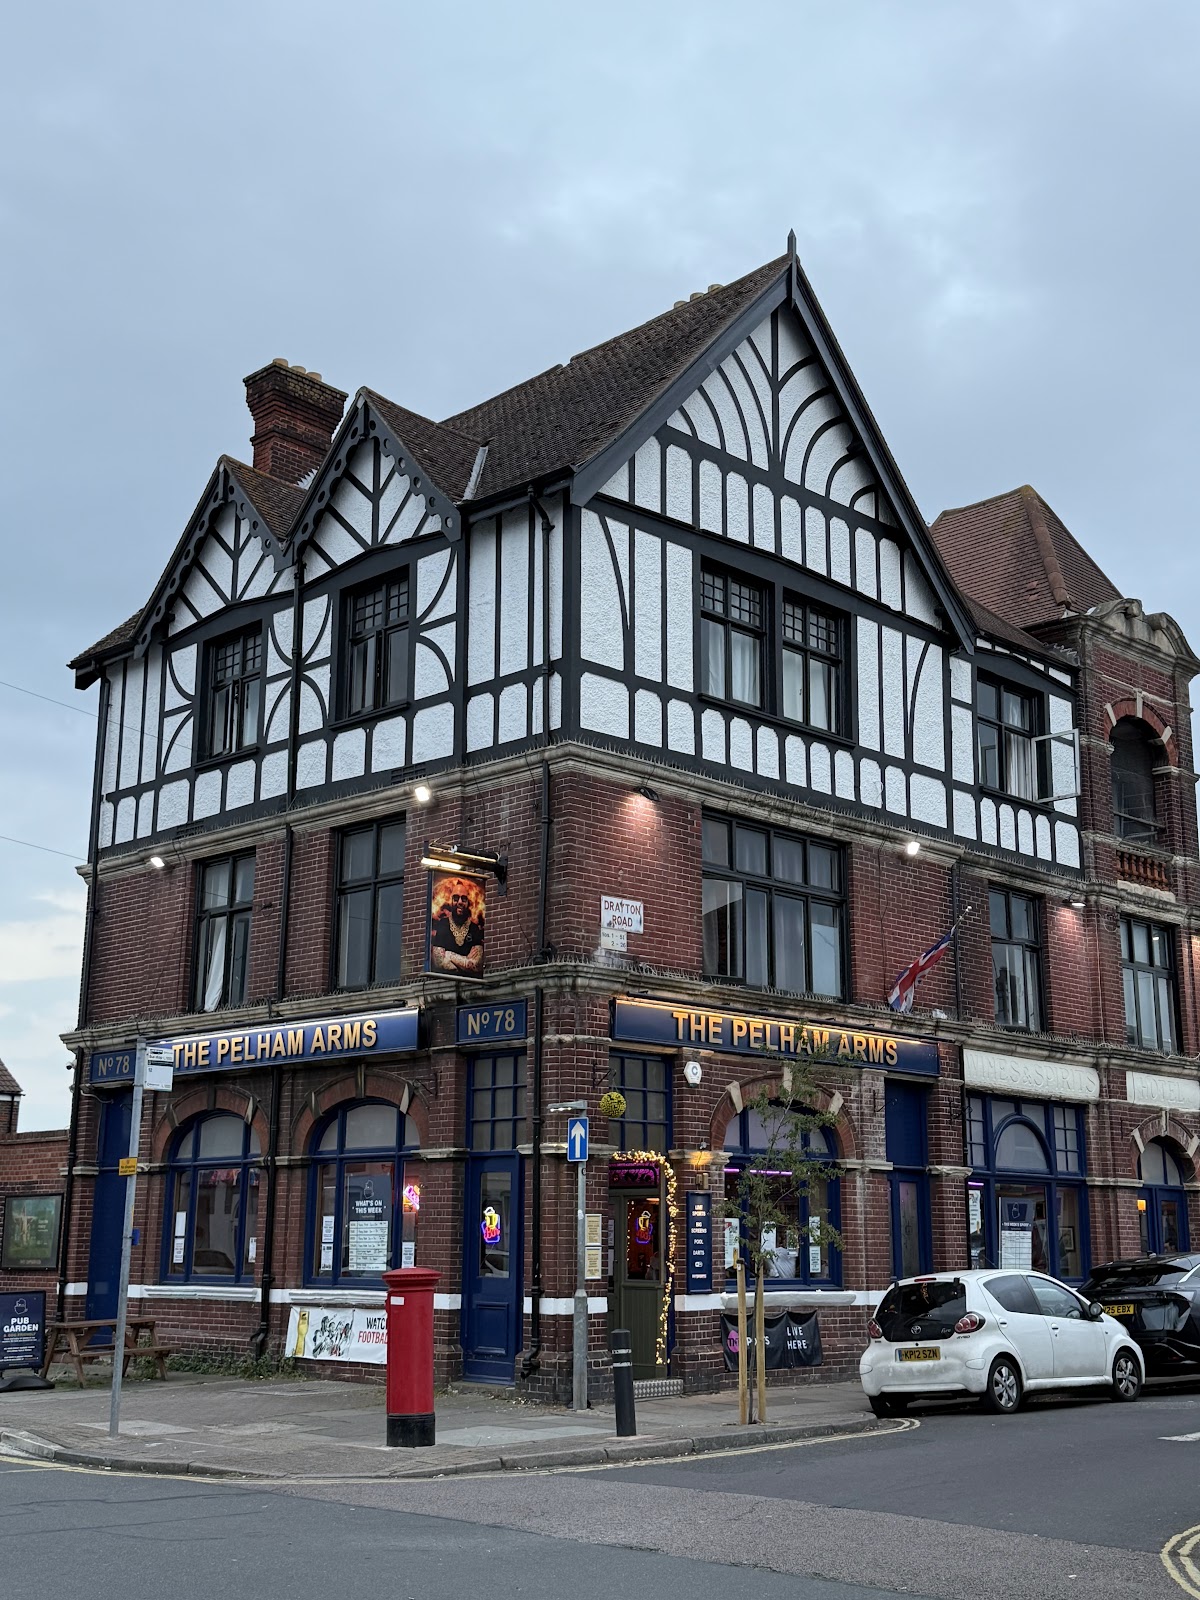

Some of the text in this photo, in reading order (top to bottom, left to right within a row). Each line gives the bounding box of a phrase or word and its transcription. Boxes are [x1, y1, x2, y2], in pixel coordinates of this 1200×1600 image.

[604, 900, 641, 915] DRAYTON
[612, 915, 633, 927] ROAD
[493, 1009, 515, 1033] 78
[172, 1019, 377, 1069] THE PELHAM ARMS
[672, 1011, 898, 1066] THE PELHAM ARMS
[115, 1055, 130, 1074] 78
[1138, 1076, 1185, 1103] HOTEL
[1116, 1305, 1131, 1313] EBX
[11, 1317, 30, 1325] PUB
[366, 1317, 388, 1330] WATC
[3, 1324, 39, 1333] GARDEN
[787, 1326, 804, 1336] LIVE
[787, 1339, 808, 1350] HERE
[903, 1348, 938, 1360] KP12 SZN
